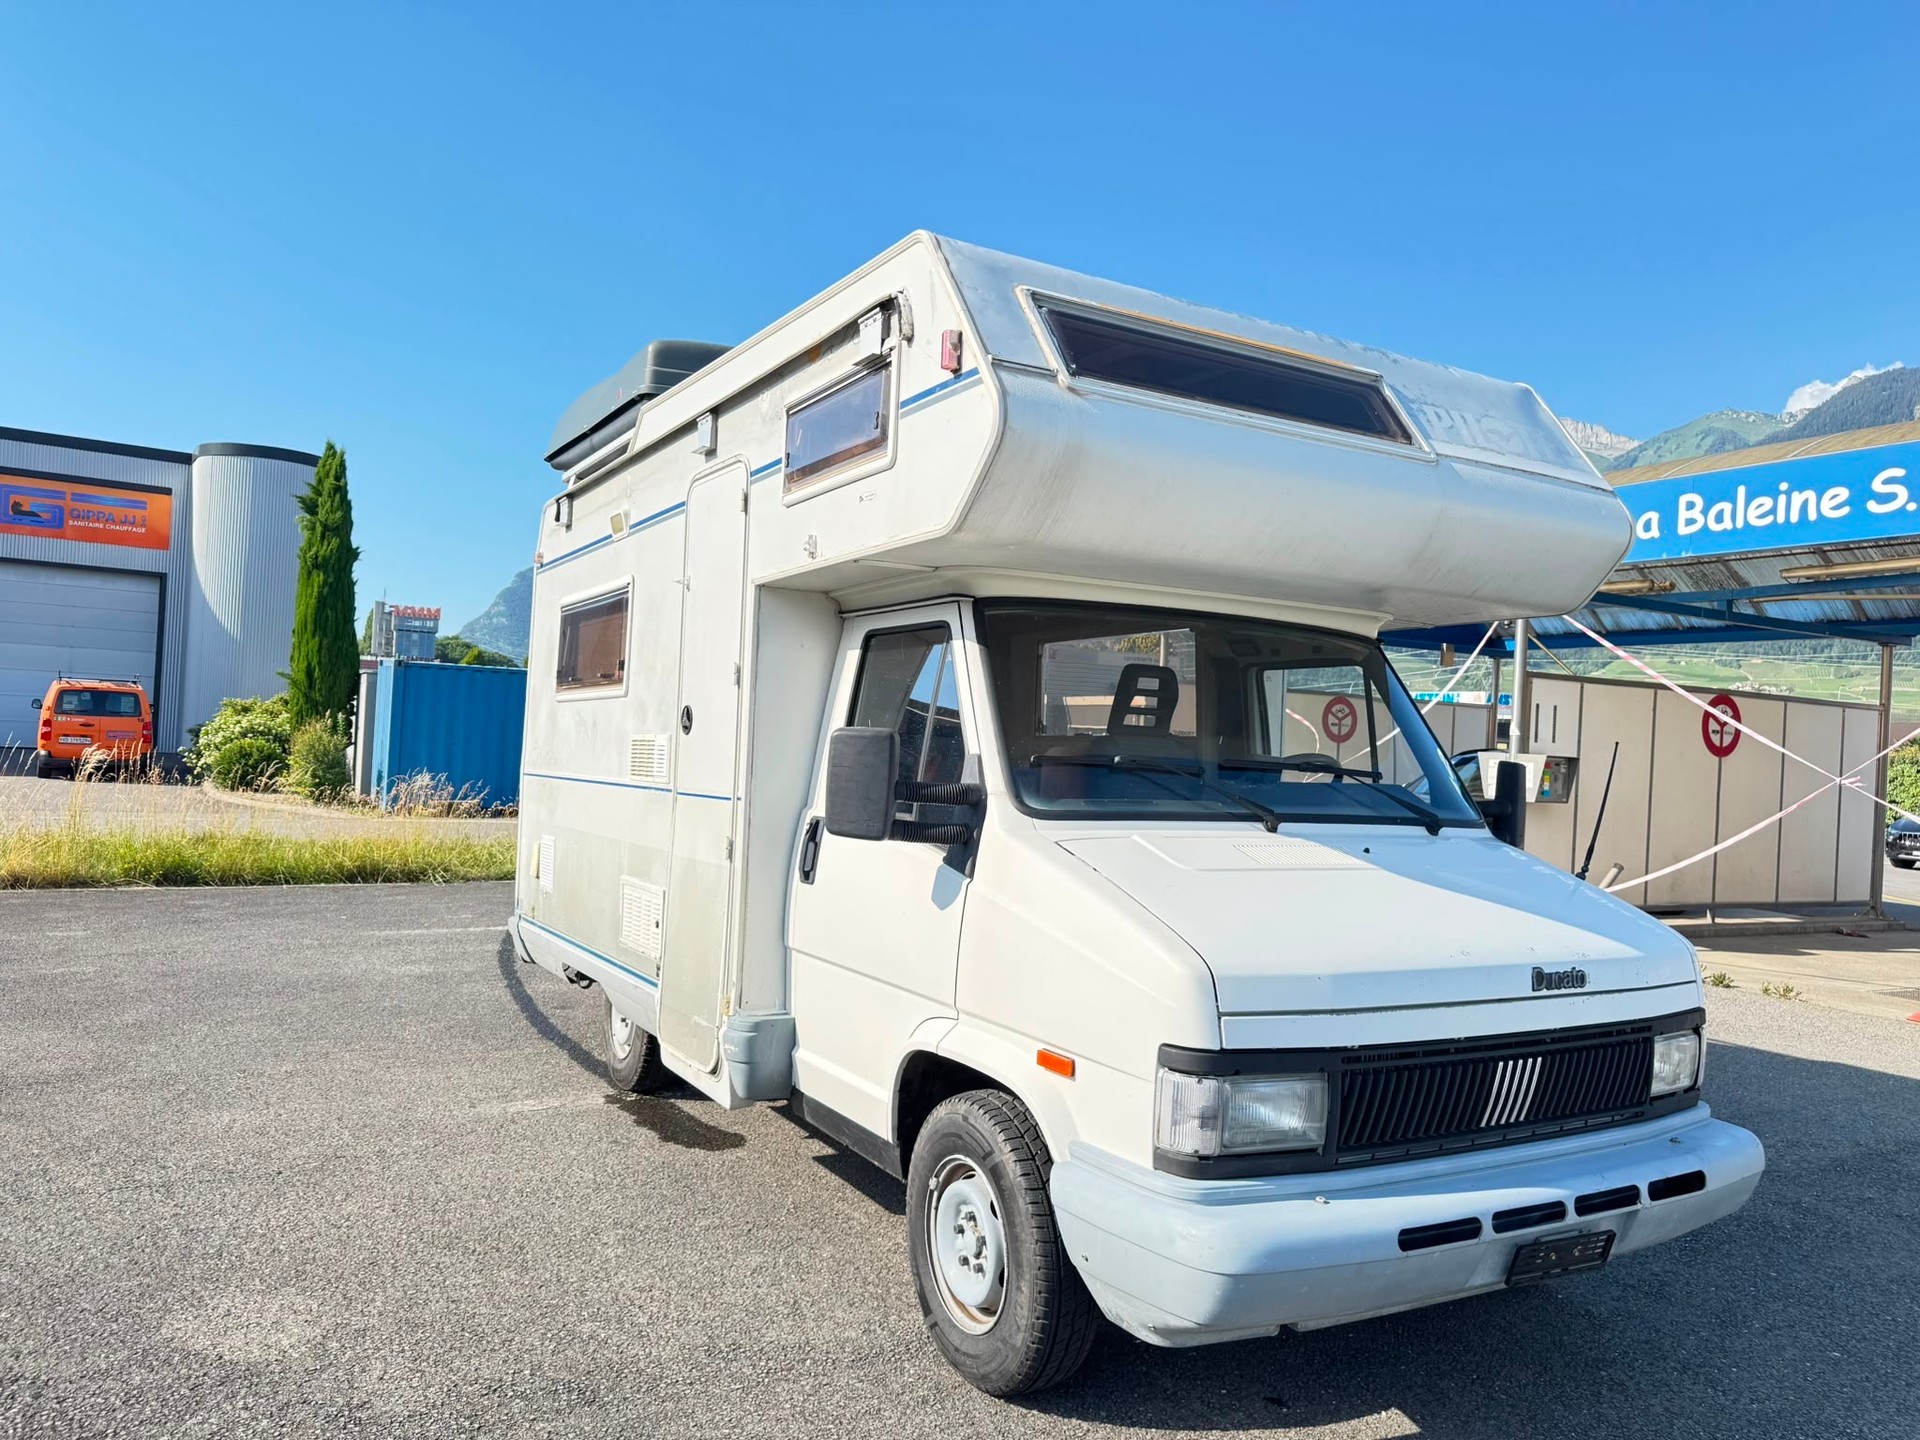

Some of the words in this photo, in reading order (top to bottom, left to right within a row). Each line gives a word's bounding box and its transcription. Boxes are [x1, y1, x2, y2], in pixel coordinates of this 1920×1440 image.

[1677, 481, 1851, 536] Baleine
[1866, 467, 1918, 514] S.
[68, 519, 105, 529] SANITAIRE
[105, 523, 147, 533] CHAUFFAGE
[1531, 966, 1588, 992] Ducato
